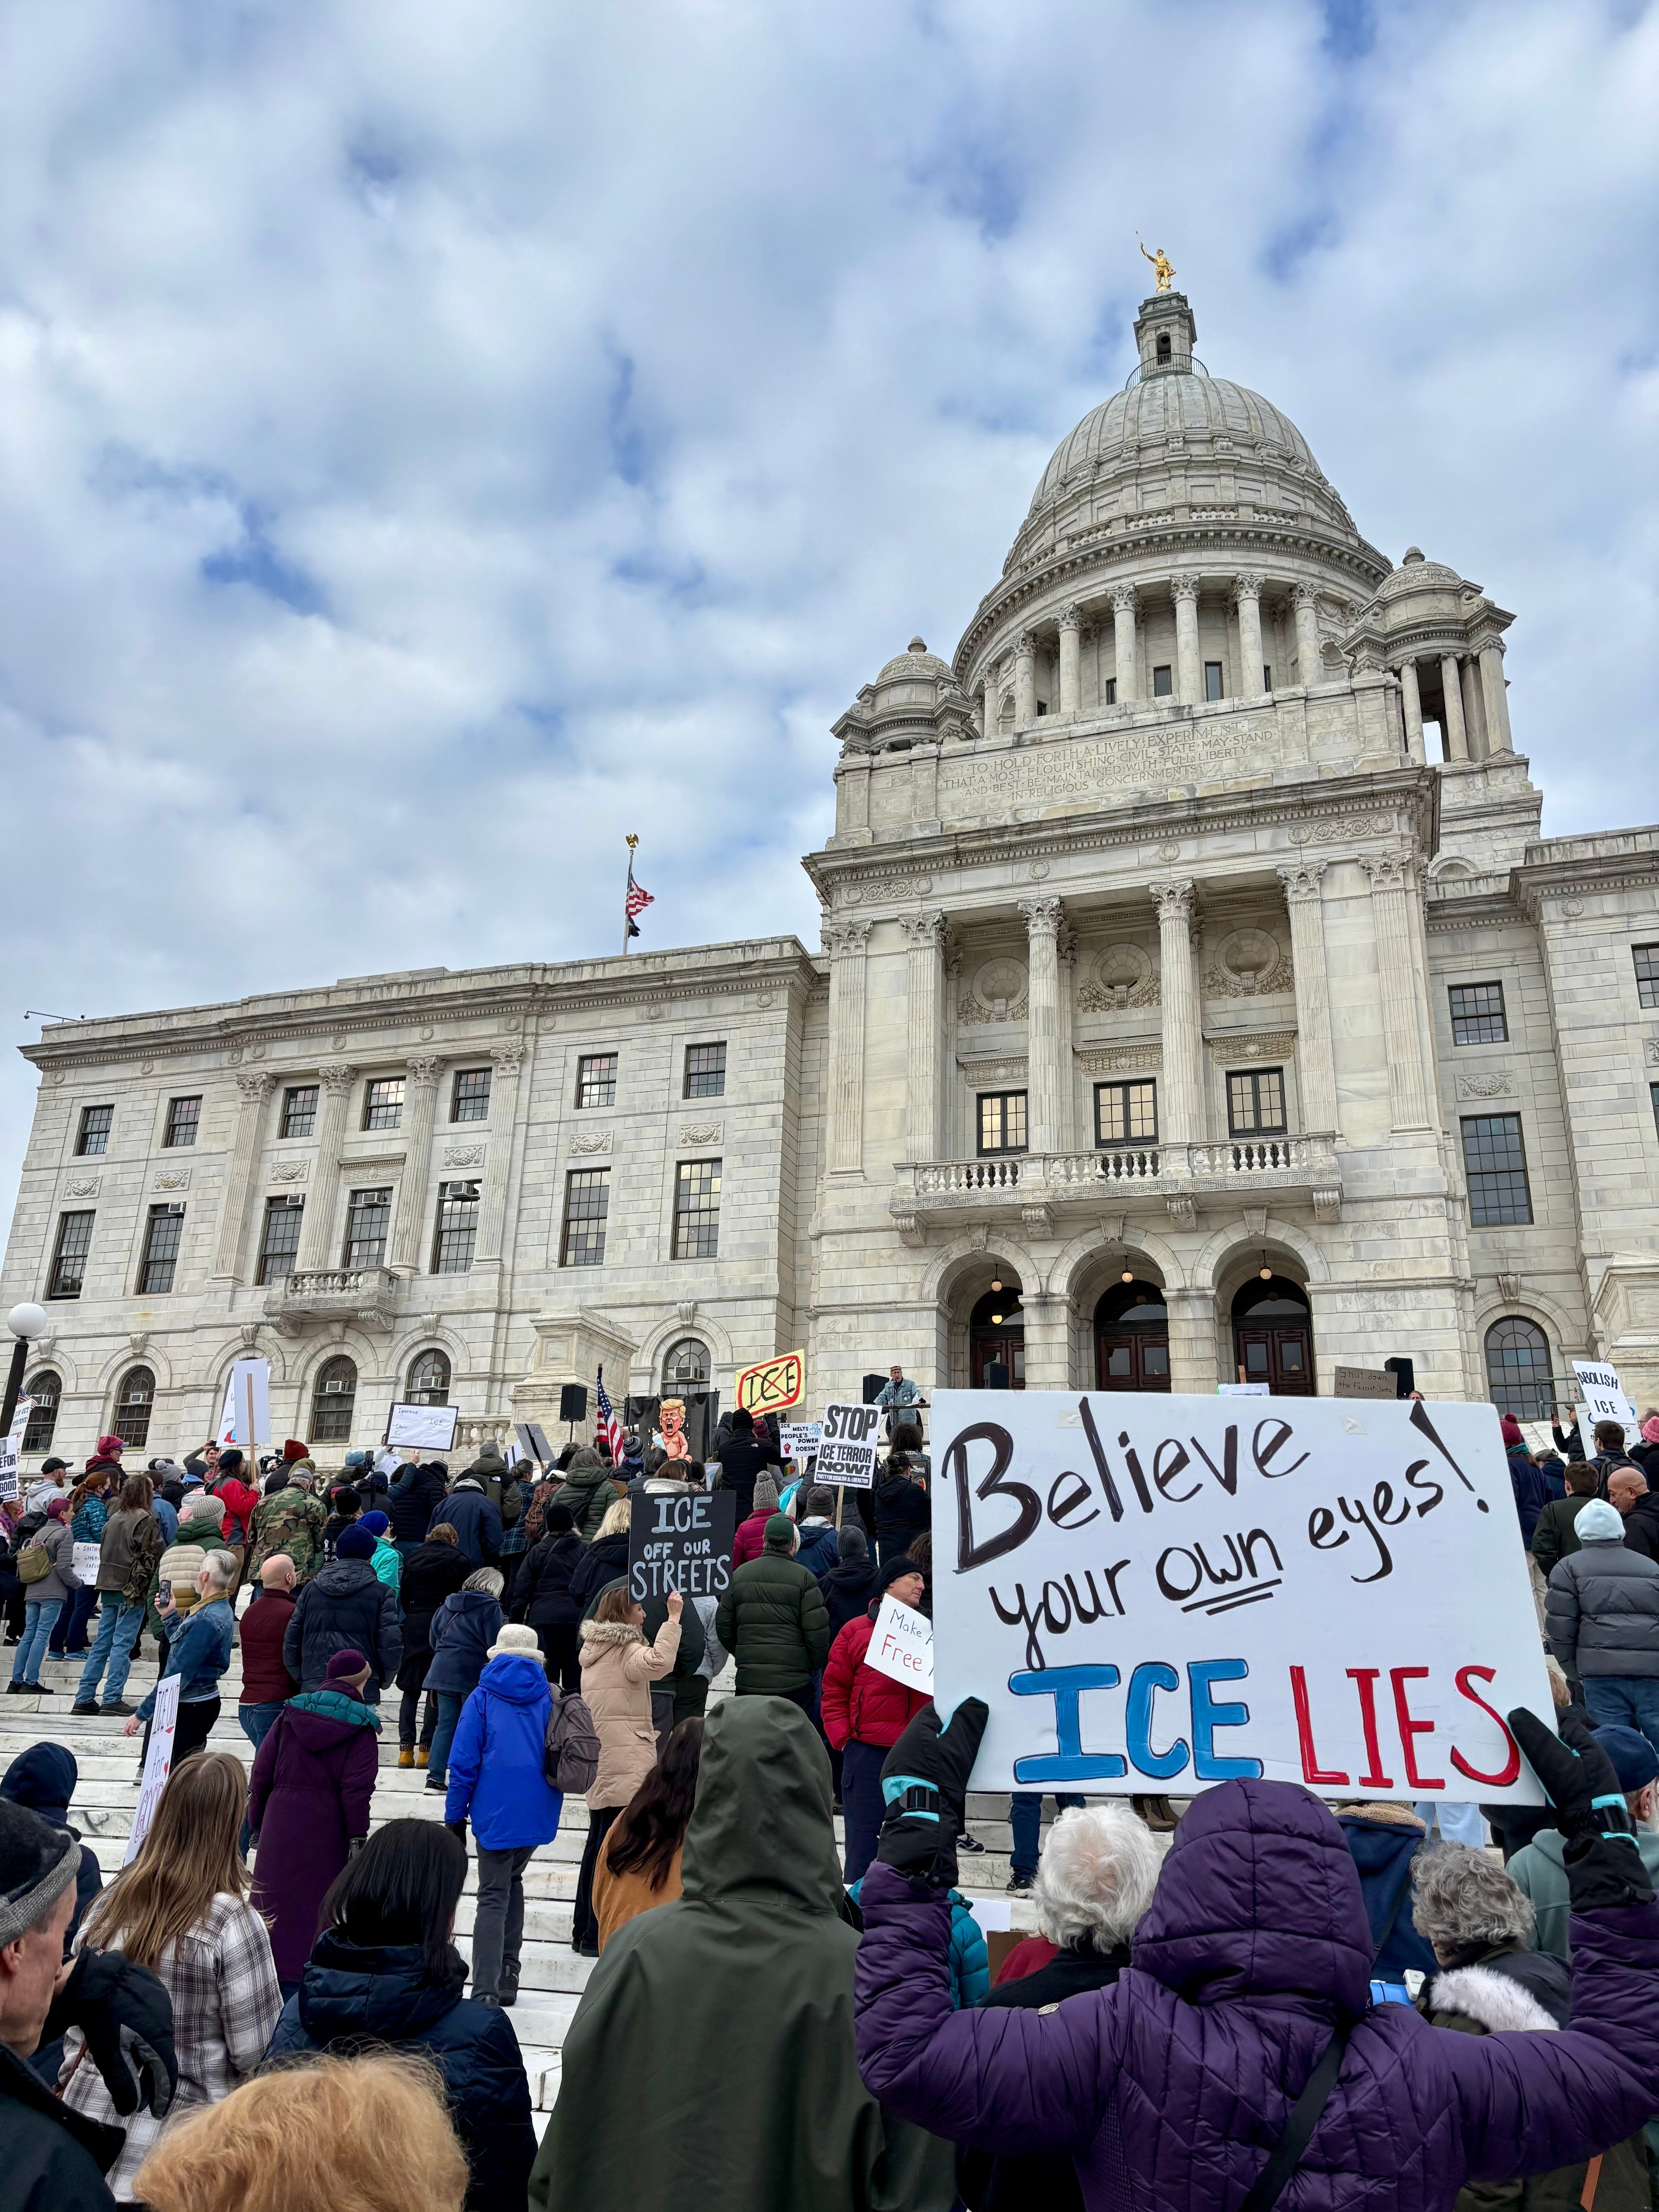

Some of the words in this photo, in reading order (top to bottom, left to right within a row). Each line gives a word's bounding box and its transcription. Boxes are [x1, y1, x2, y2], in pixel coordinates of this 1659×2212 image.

[943, 776, 975, 790] THAT
[978, 775, 986, 783] A
[990, 769, 1022, 783] MOST
[1028, 755, 1115, 776] FLOURISHING
[1120, 749, 1153, 763] CIVIL
[1158, 742, 1196, 757] STATE
[1202, 737, 1228, 748] MAY
[1233, 730, 1272, 745] STAND
[969, 763, 988, 774] TO
[994, 756, 1031, 771] HOLD
[1037, 748, 1079, 763] FORTH
[1083, 746, 1092, 756] A
[1096, 737, 1143, 755] LIVELY
[1147, 721, 1242, 747] EXPERIMENT
[965, 786, 988, 797] AND
[993, 780, 1021, 792] BEST
[1027, 778, 1042, 787] BE
[1047, 765, 1121, 784] MAINTAINED
[1127, 759, 1157, 772] WITH
[1163, 754, 1194, 767] FULL
[1198, 745, 1249, 761] LIBERTY
[1012, 790, 1023, 801] IN
[1029, 781, 1089, 799] RELIGIOUS
[1096, 765, 1197, 787] CONCERNMENTS
[745, 1362, 796, 1408] ICE
[1339, 1367, 1364, 1379] Shut
[1368, 1372, 1387, 1381] down
[1577, 1371, 1618, 1389] ABOLISH
[824, 1405, 878, 1441] STOP
[1594, 1399, 1618, 1414] ICE
[3, 1454, 16, 1468] FOR
[817, 1460, 871, 1475] NOW!
[819, 1444, 836, 1460] ICE
[837, 1446, 873, 1463] TERROR
[941, 1396, 1312, 1575] Believe
[651, 1496, 713, 1534] ICE
[643, 1542, 673, 1560] OFF
[684, 1538, 711, 1556] OUR
[989, 1559, 1130, 1672] your
[1156, 1528, 1284, 1601] own
[1309, 1401, 1489, 1583] eyes!
[631, 1554, 731, 1601] STREETS
[890, 1609, 922, 1637] Make
[881, 1633, 922, 1671] Free
[1008, 1659, 1264, 1784] ICE
[1289, 1666, 1520, 1789] LIES
[151, 1745, 165, 1781] for
